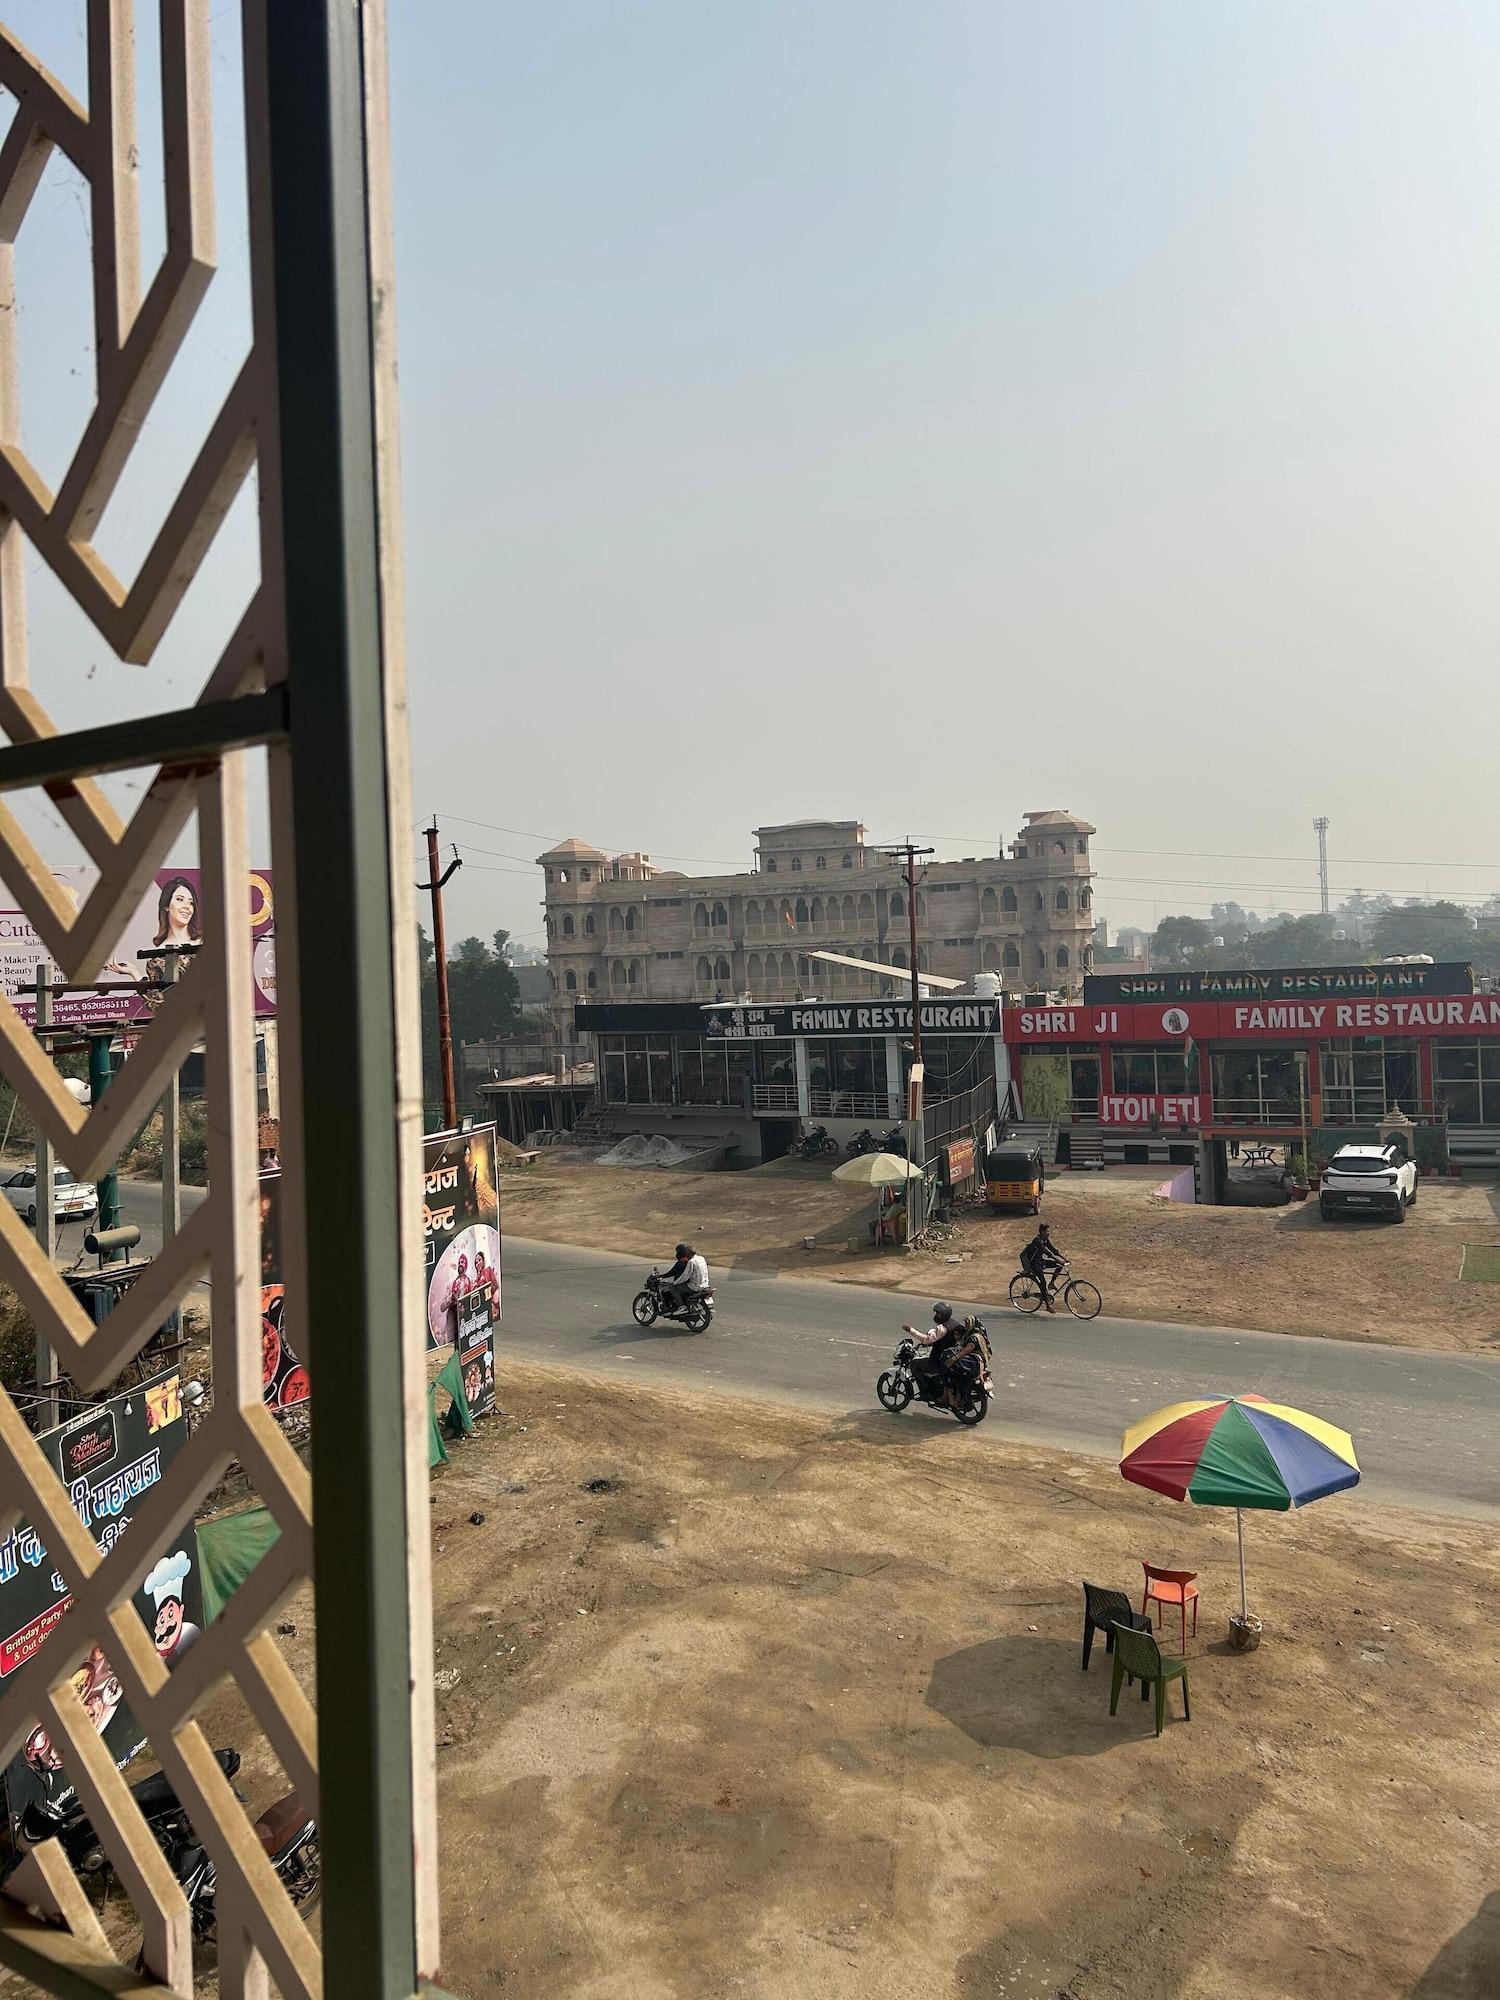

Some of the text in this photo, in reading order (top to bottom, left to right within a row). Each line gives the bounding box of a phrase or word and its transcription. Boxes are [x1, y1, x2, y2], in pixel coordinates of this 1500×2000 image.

[4, 955, 40, 964] Make UP
[4, 967, 33, 976] Beauty
[1120, 971, 1427, 997] SHRI JI FAMILY RESTAURANT
[791, 1008, 852, 1029] FAMILY
[1020, 1012, 1076, 1033] SHRI
[1095, 1012, 1118, 1033] JI
[1235, 1006, 1326, 1028] FAMILY
[69, 1435, 99, 1457] Dauji
[80, 1431, 97, 1446] Shri
[71, 1434, 112, 1466] Maharaj
[91, 1446, 162, 1519] महाराज
[5, 1624, 40, 1655] Brithday
[22, 1641, 37, 1655] Out
